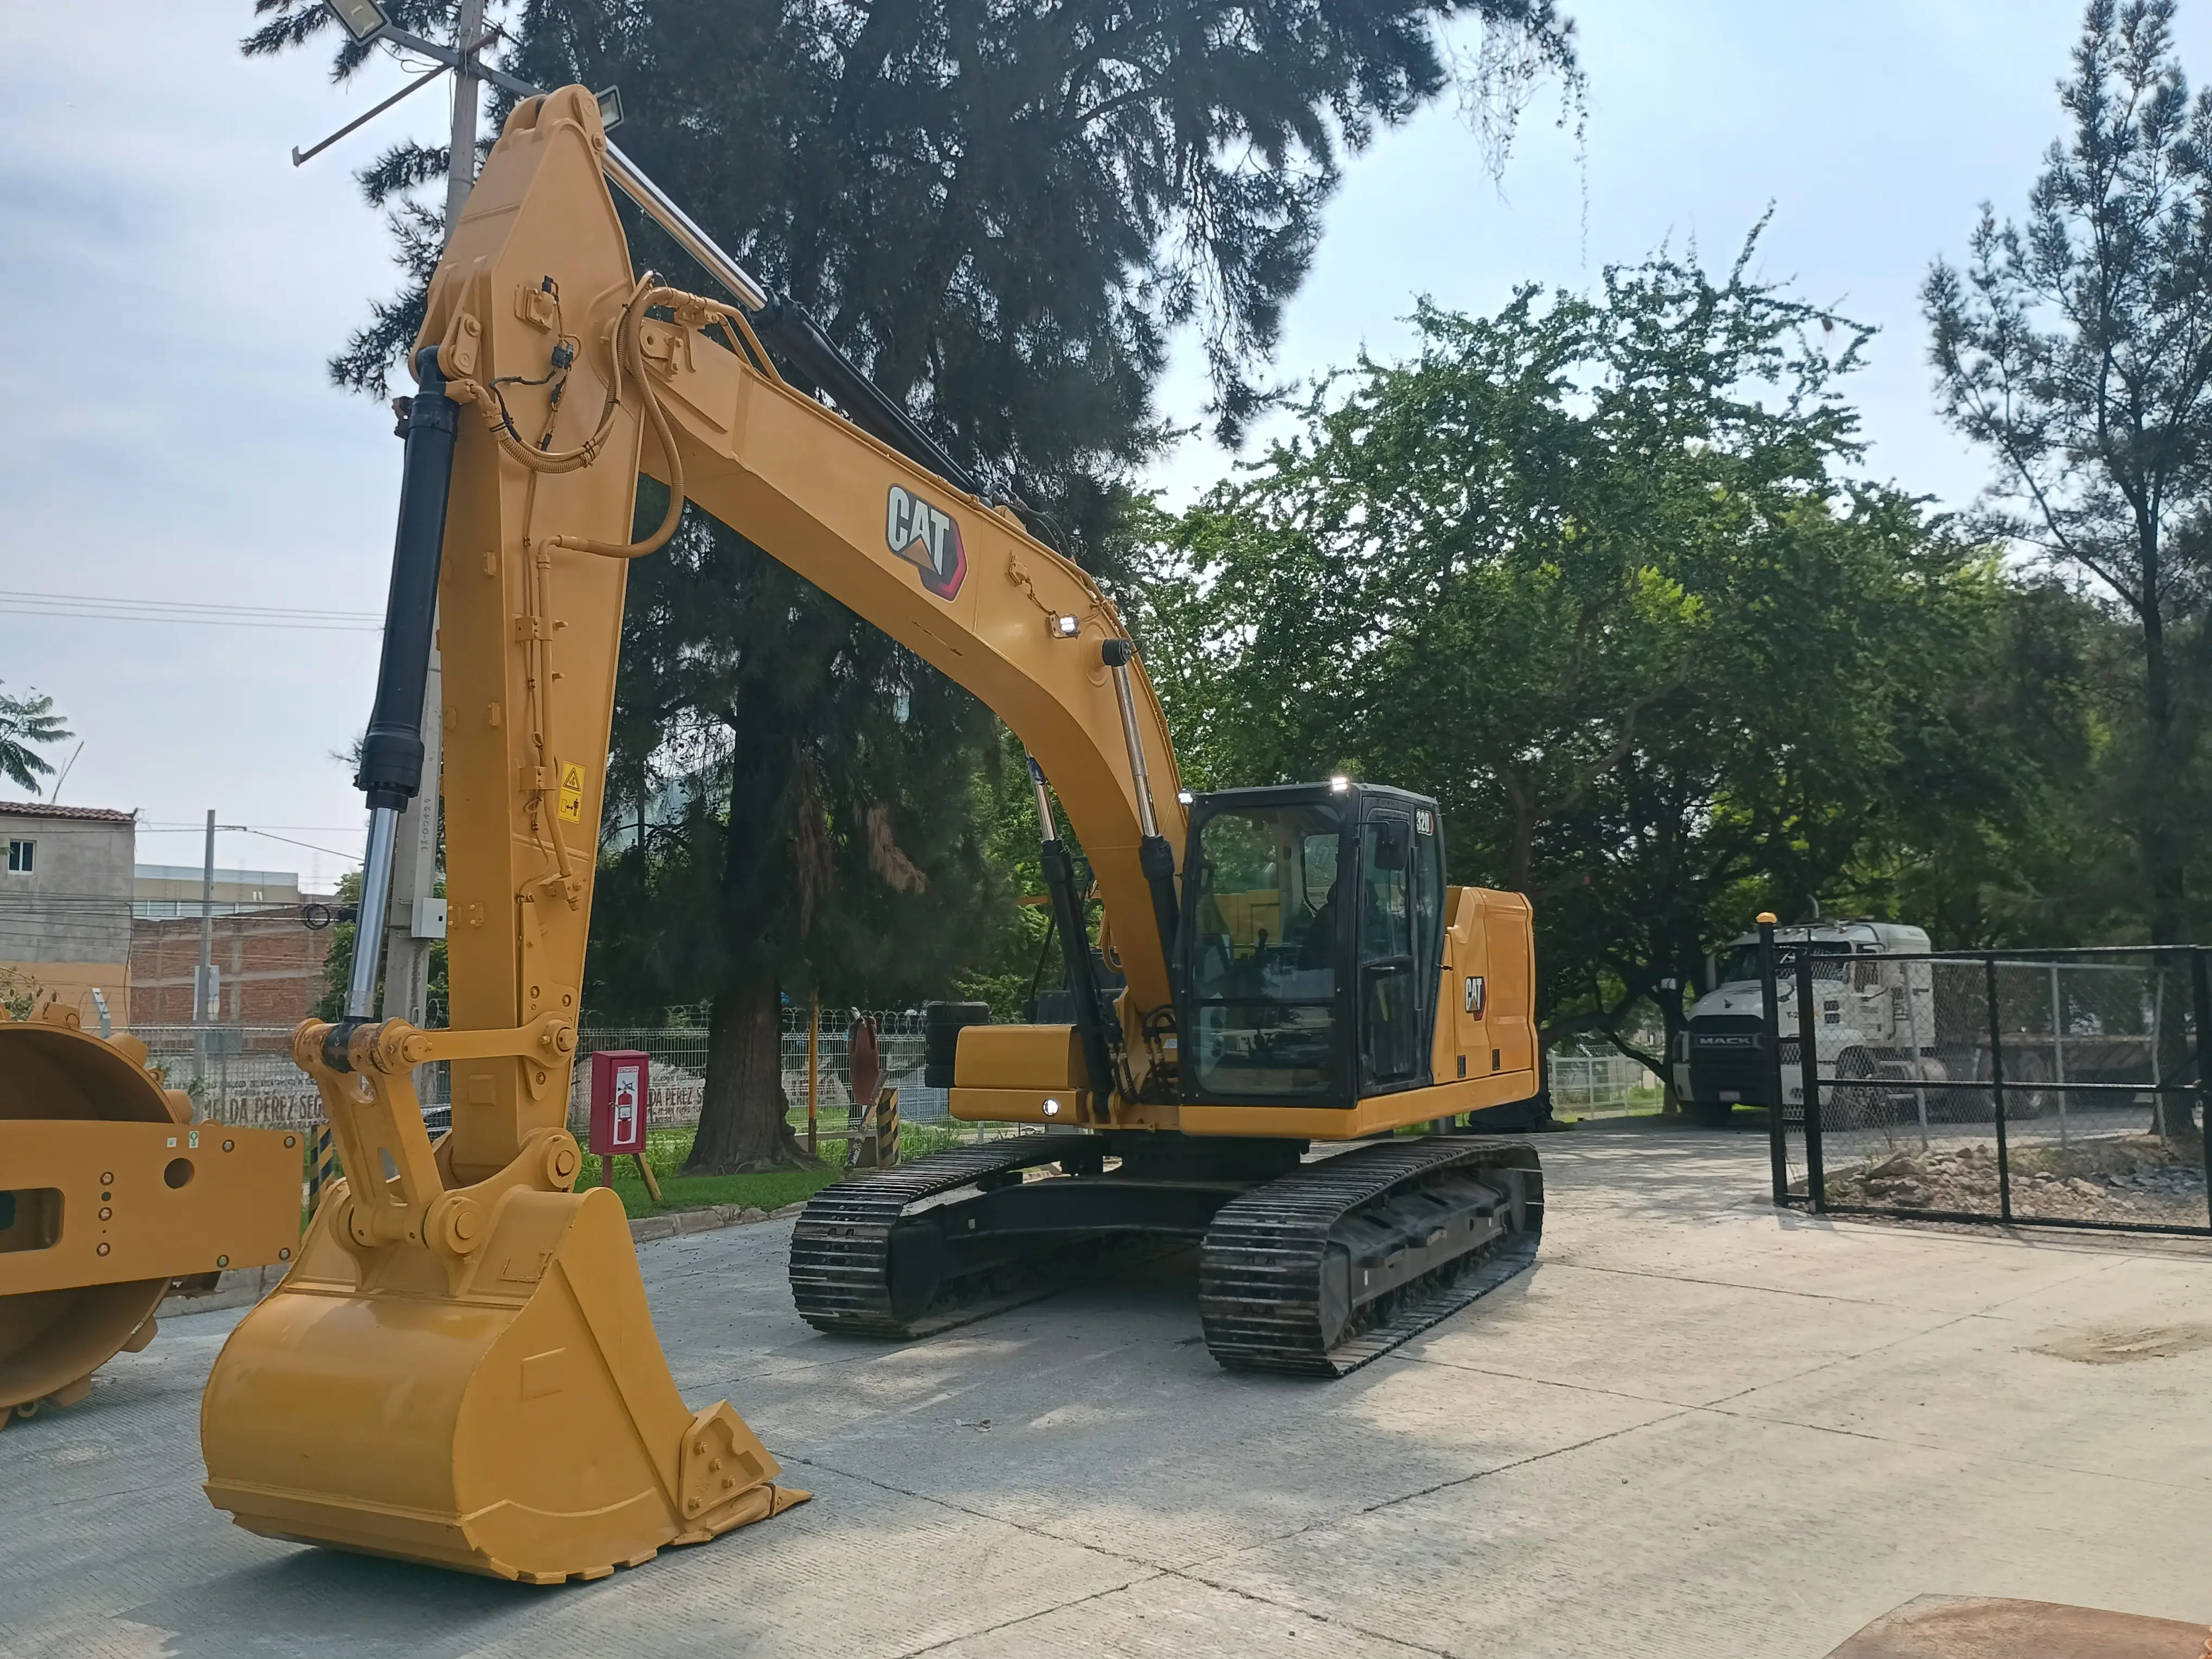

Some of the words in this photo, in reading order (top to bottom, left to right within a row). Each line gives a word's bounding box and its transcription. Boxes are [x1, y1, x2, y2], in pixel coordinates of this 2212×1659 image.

[888, 487, 949, 575] CAT
[1416, 811, 1429, 832] 320
[1465, 978, 1482, 1011] CAT
